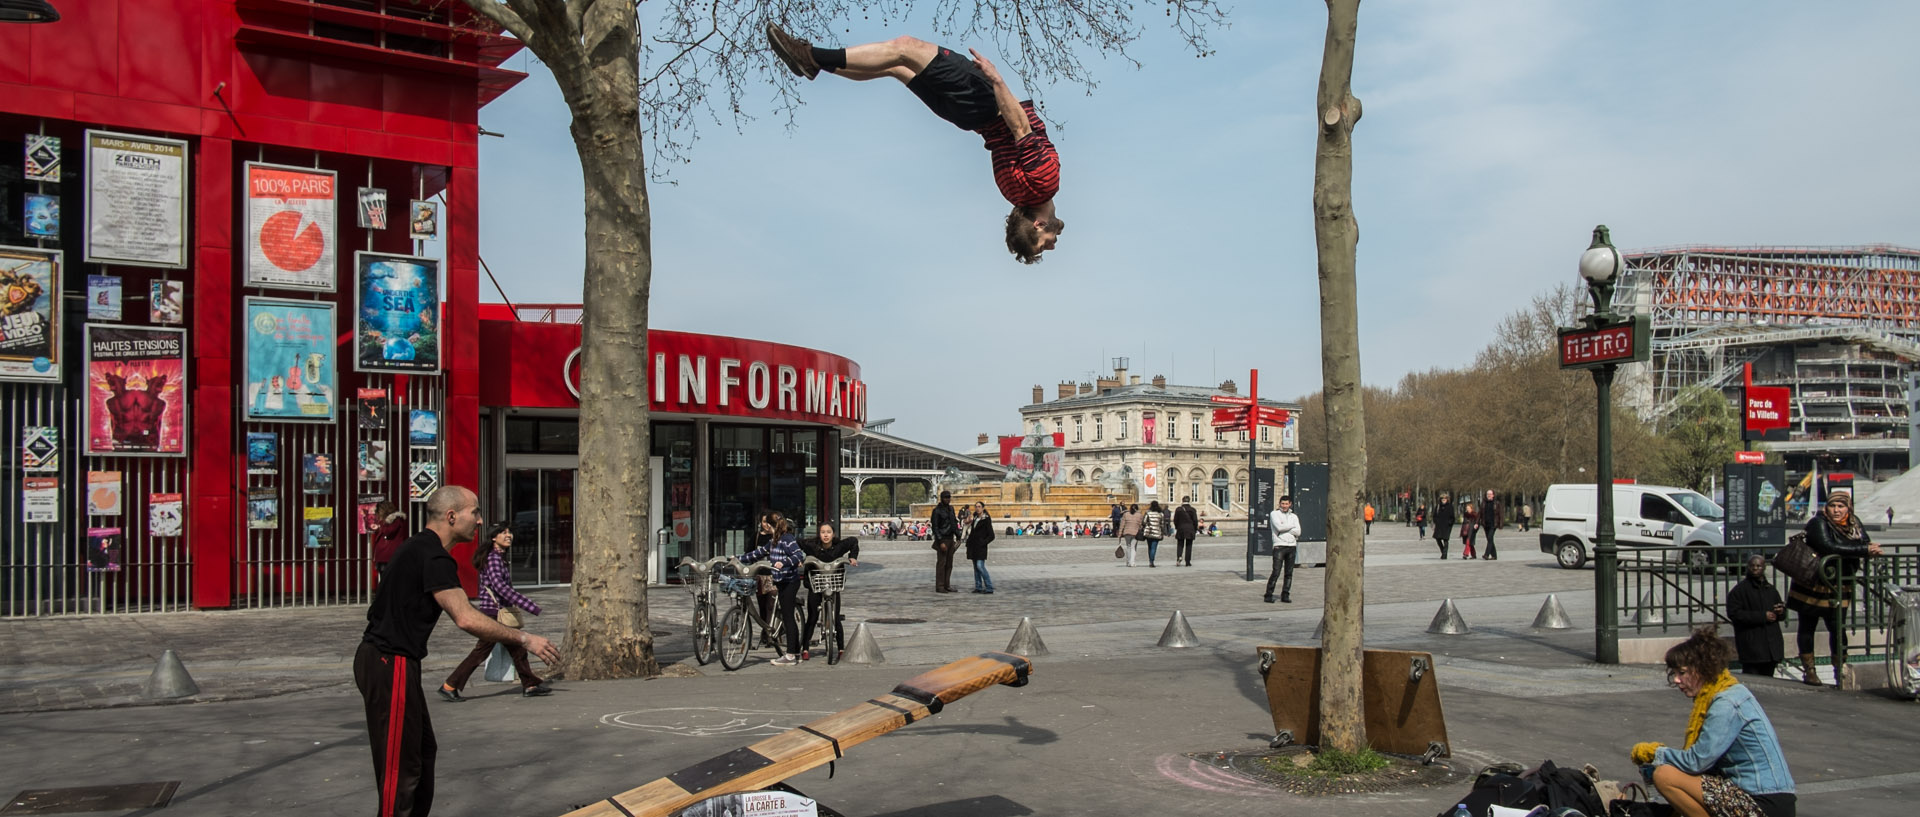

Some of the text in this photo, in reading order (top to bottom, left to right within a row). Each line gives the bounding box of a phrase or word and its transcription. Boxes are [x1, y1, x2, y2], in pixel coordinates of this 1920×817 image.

[101, 138, 125, 147] MARS
[130, 142, 153, 151] AVRIL
[154, 145, 174, 153] 2014
[253, 178, 330, 194] 100% PARIS
[383, 295, 415, 313] SEA
[93, 339, 179, 352] HAUTES TENSIONS
[1567, 332, 1628, 360] METRO
[1749, 398, 1773, 408] Parc de
[1749, 409, 1779, 420] la Villette
[745, 799, 787, 812] LA CARTE B.
